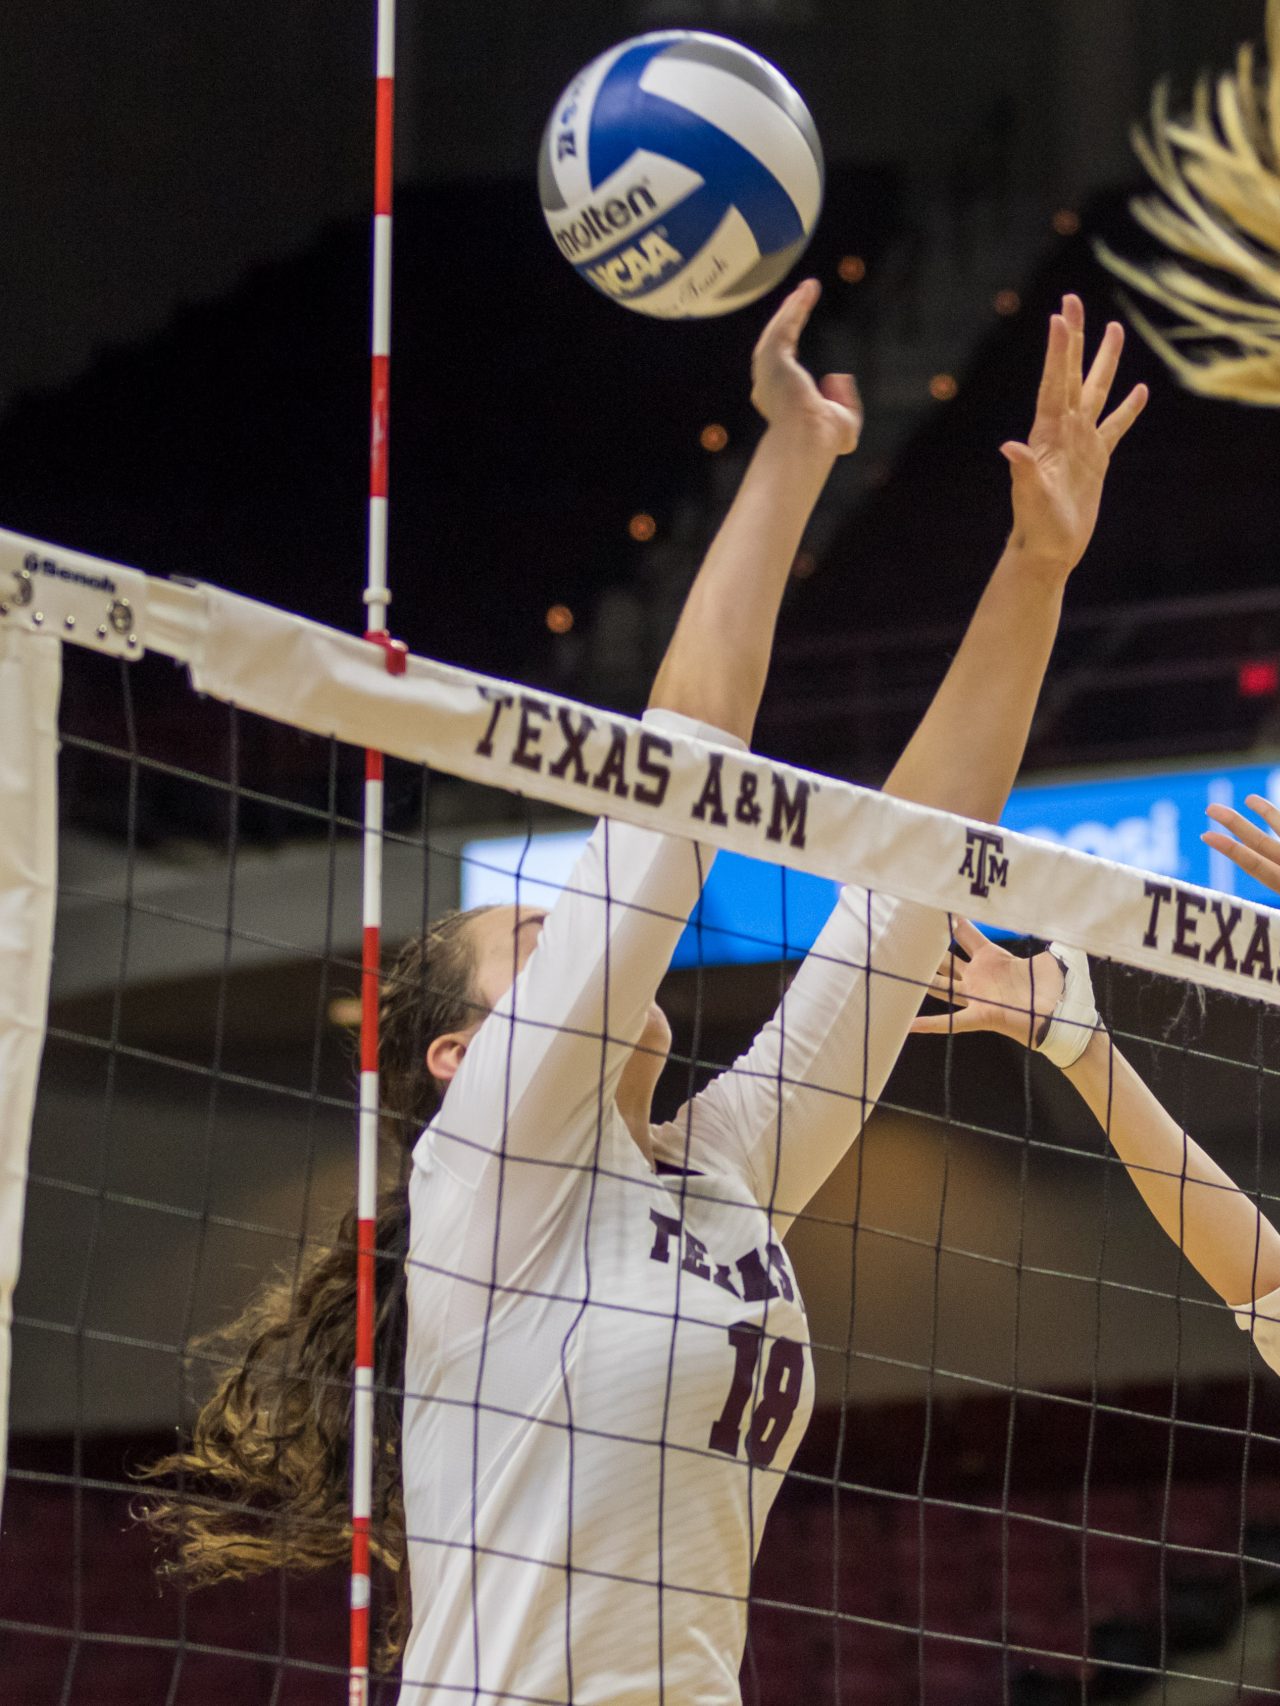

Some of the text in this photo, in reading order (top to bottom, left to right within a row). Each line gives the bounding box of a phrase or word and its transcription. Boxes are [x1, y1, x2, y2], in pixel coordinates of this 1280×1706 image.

[555, 185, 657, 257] molten
[585, 230, 683, 295] NCAA
[474, 685, 811, 850] TEXAS A&M
[708, 1320, 804, 1471] 18
